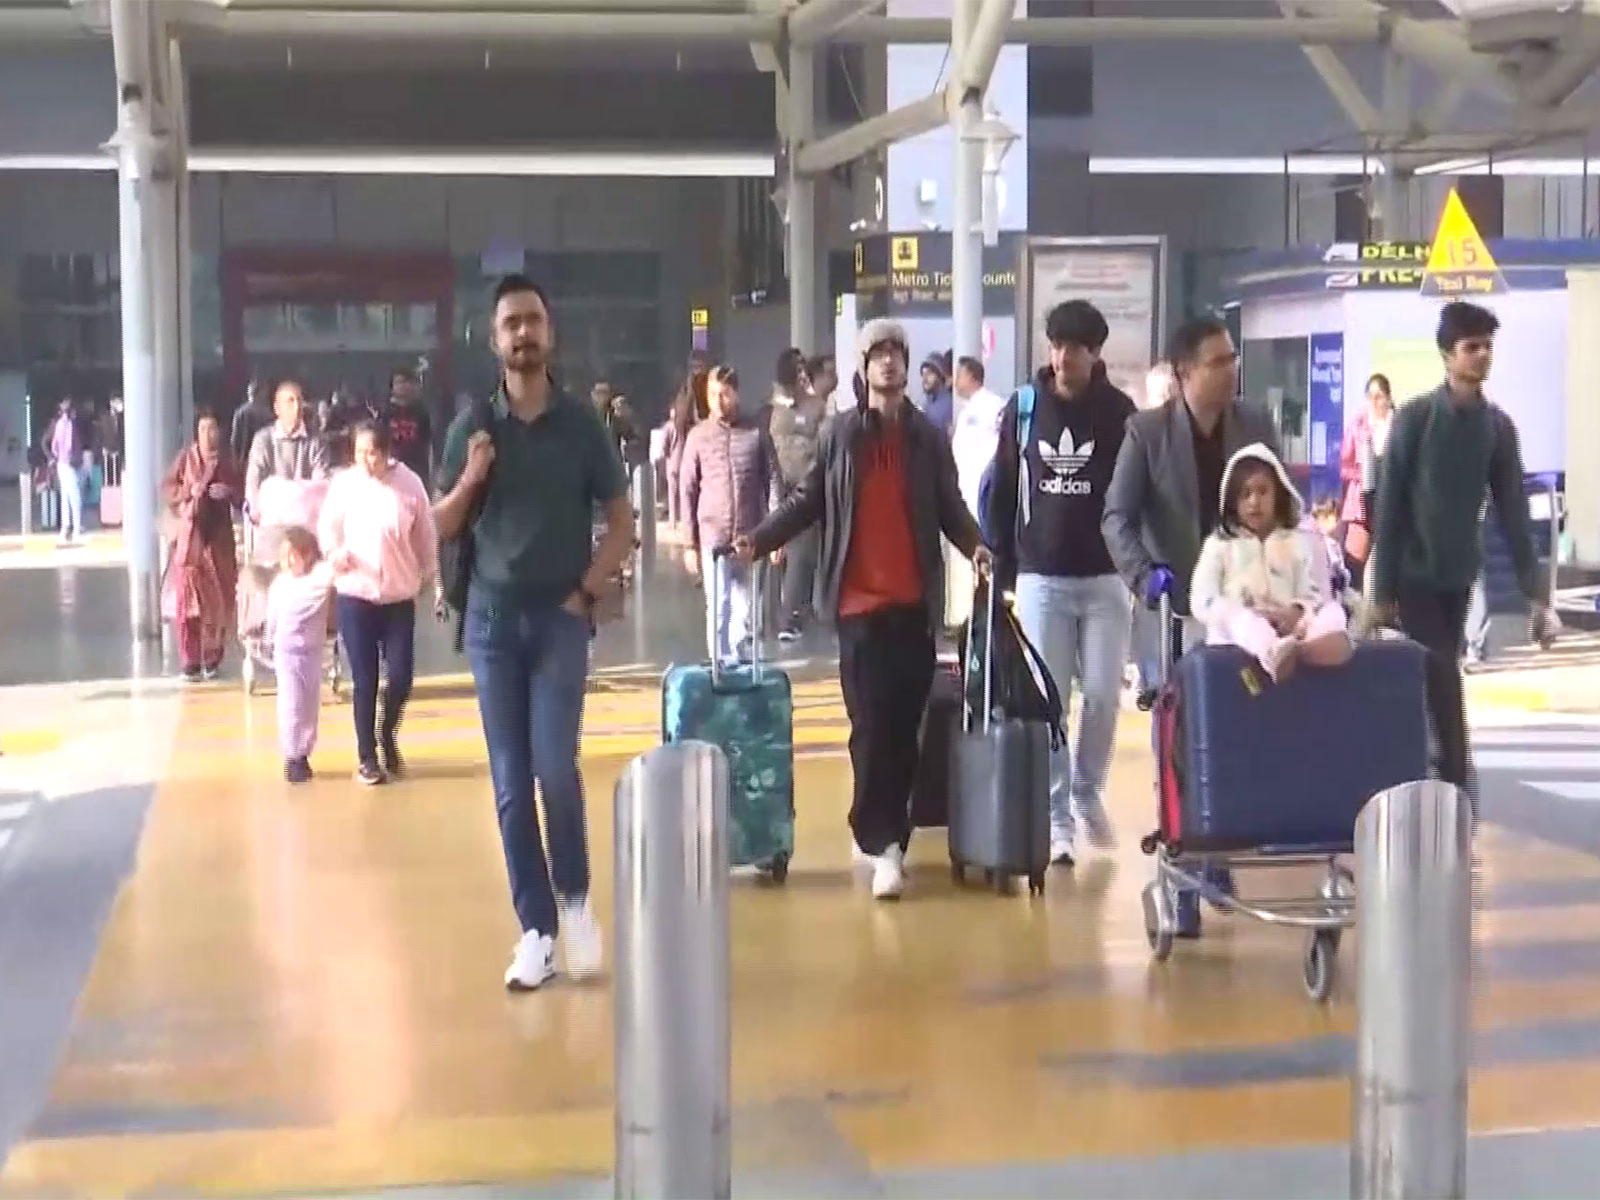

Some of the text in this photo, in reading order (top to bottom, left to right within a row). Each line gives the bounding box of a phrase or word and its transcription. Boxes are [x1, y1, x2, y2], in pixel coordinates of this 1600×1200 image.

[1362, 245, 1430, 259] DELH
[892, 271, 1016, 287] Metro Tic ounte
[1039, 476, 1091, 494] adidas
